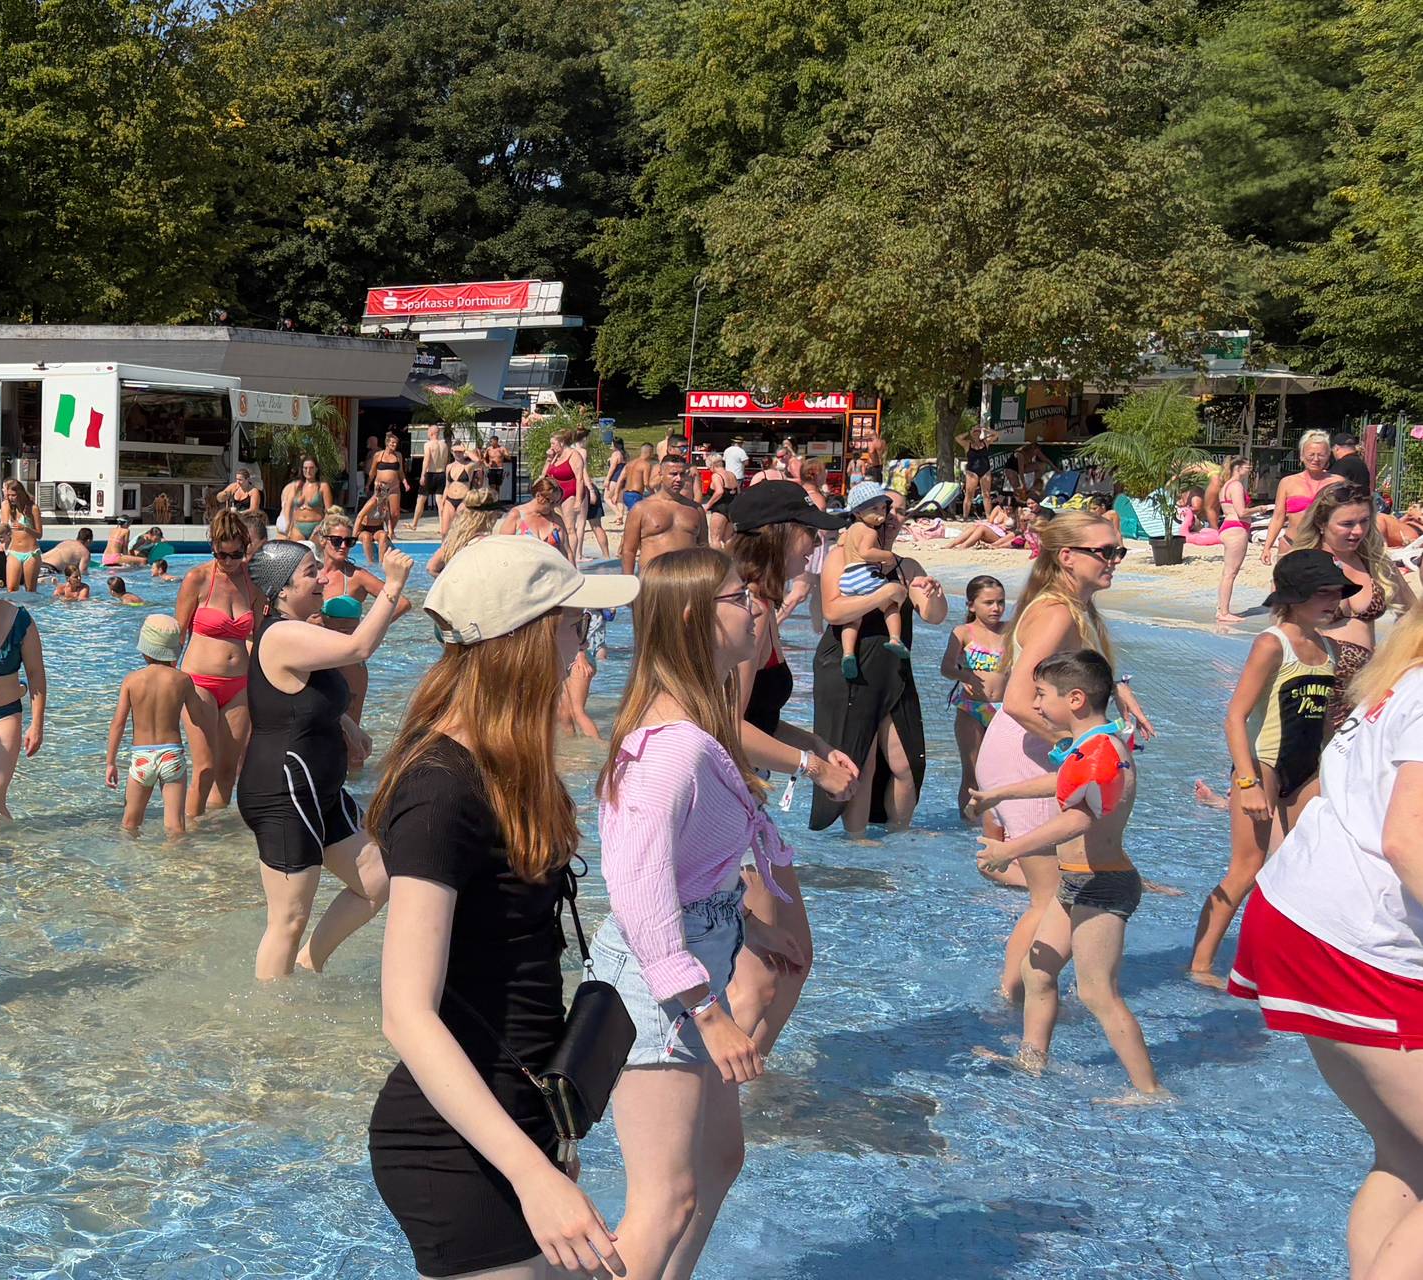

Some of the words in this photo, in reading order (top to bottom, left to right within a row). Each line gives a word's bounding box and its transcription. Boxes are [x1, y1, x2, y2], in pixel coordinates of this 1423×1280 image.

[400, 299, 454, 311] Sparkasse
[457, 296, 511, 308] Dortmund
[690, 395, 748, 408] LATINO
[1291, 683, 1332, 699] SUMME
